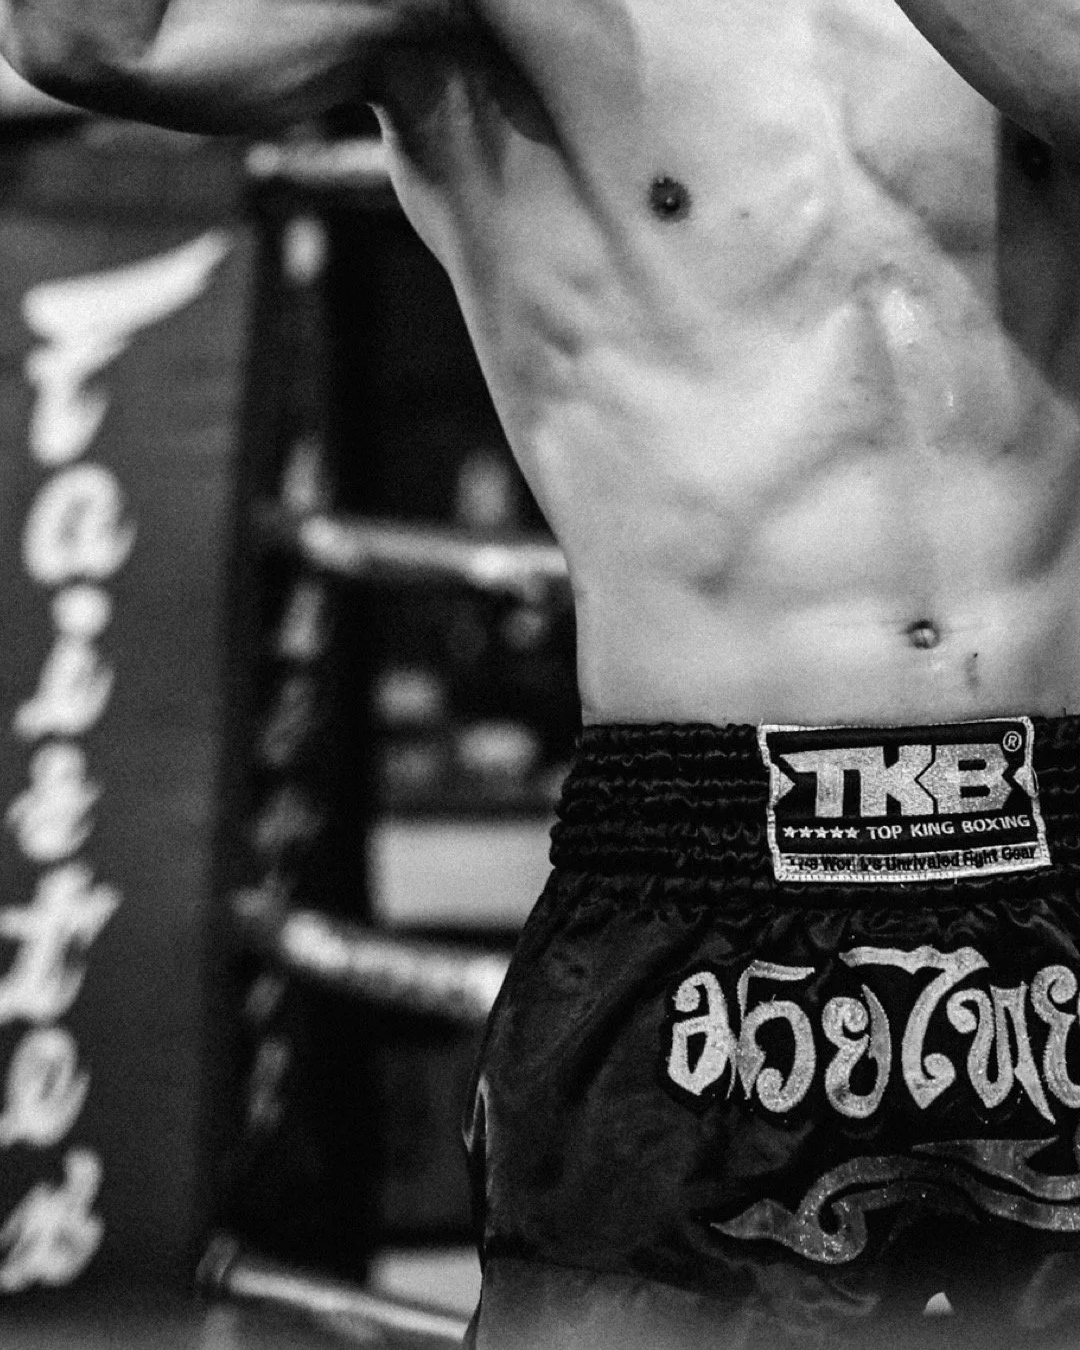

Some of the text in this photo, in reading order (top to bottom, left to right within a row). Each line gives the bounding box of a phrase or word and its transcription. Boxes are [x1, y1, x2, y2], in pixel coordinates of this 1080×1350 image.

[779, 743, 1012, 818] TKB
[866, 814, 1031, 840] TOP KING BOXING
[1001, 844, 1037, 861] Gear
